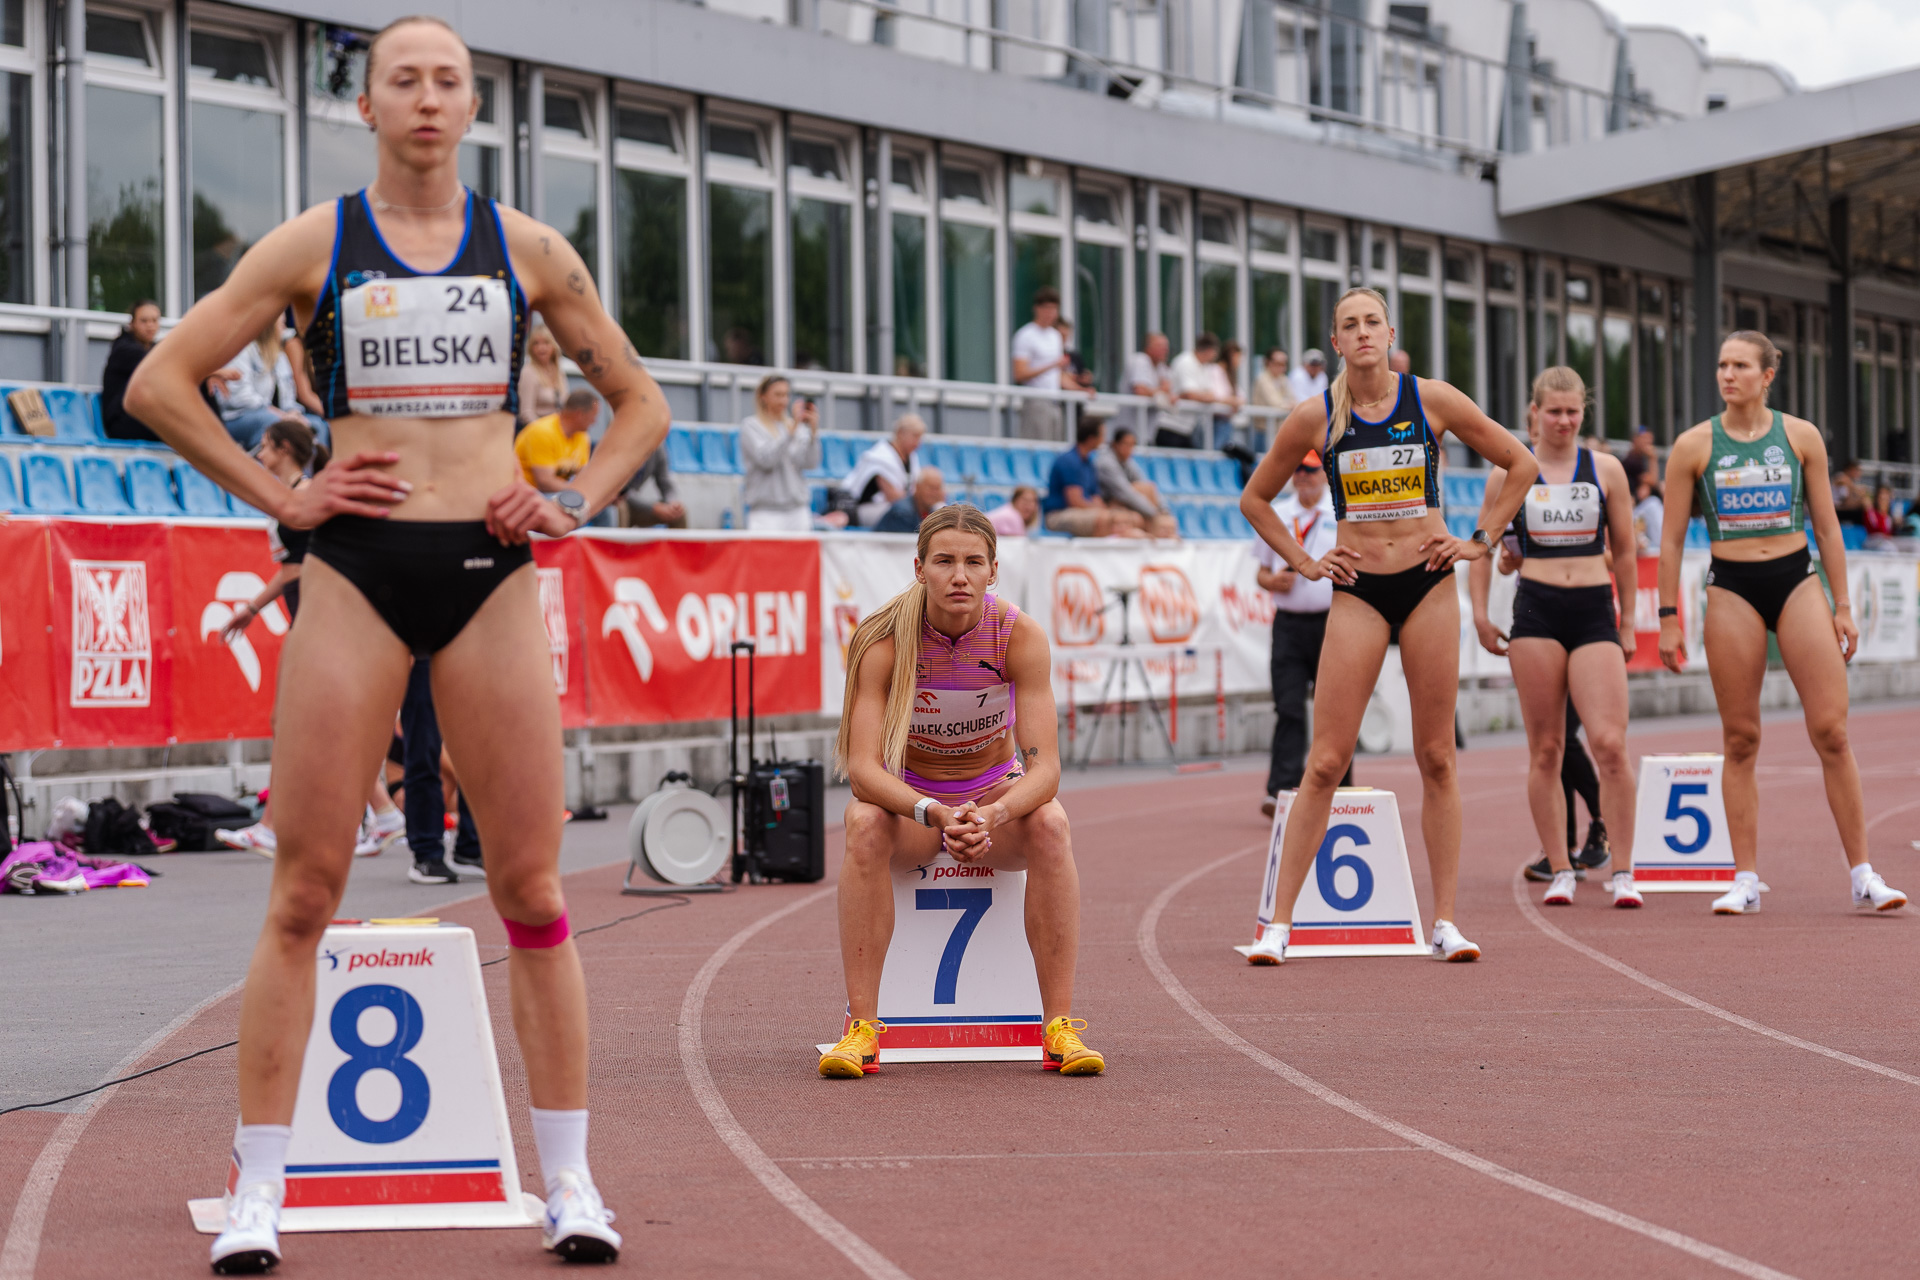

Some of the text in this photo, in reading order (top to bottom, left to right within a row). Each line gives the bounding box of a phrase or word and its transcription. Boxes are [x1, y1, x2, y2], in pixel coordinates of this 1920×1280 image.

[446, 285, 489, 312] 24
[361, 335, 497, 367] BIELSKA
[370, 401, 456, 414] WARSZAWA
[1392, 449, 1415, 465] 27
[1763, 469, 1782, 482] 15
[1345, 475, 1422, 496] LIGARSKA
[1571, 486, 1590, 500] 23
[1722, 490, 1786, 509] SŁOCKA
[1355, 511, 1400, 520] WARSZAWA
[1543, 509, 1584, 523] BAAS
[676, 591, 807, 661] ORLEN
[78, 659, 146, 697] PZLA
[914, 706, 941, 714] ORLEN
[976, 693, 989, 708] 7
[916, 741, 973, 755] WARSZAWA
[1664, 783, 1712, 854] 5
[933, 863, 995, 881] polanik
[1316, 823, 1375, 912] 6
[915, 888, 992, 1004] 7
[348, 948, 435, 972] polanik
[327, 984, 431, 1144] 8
